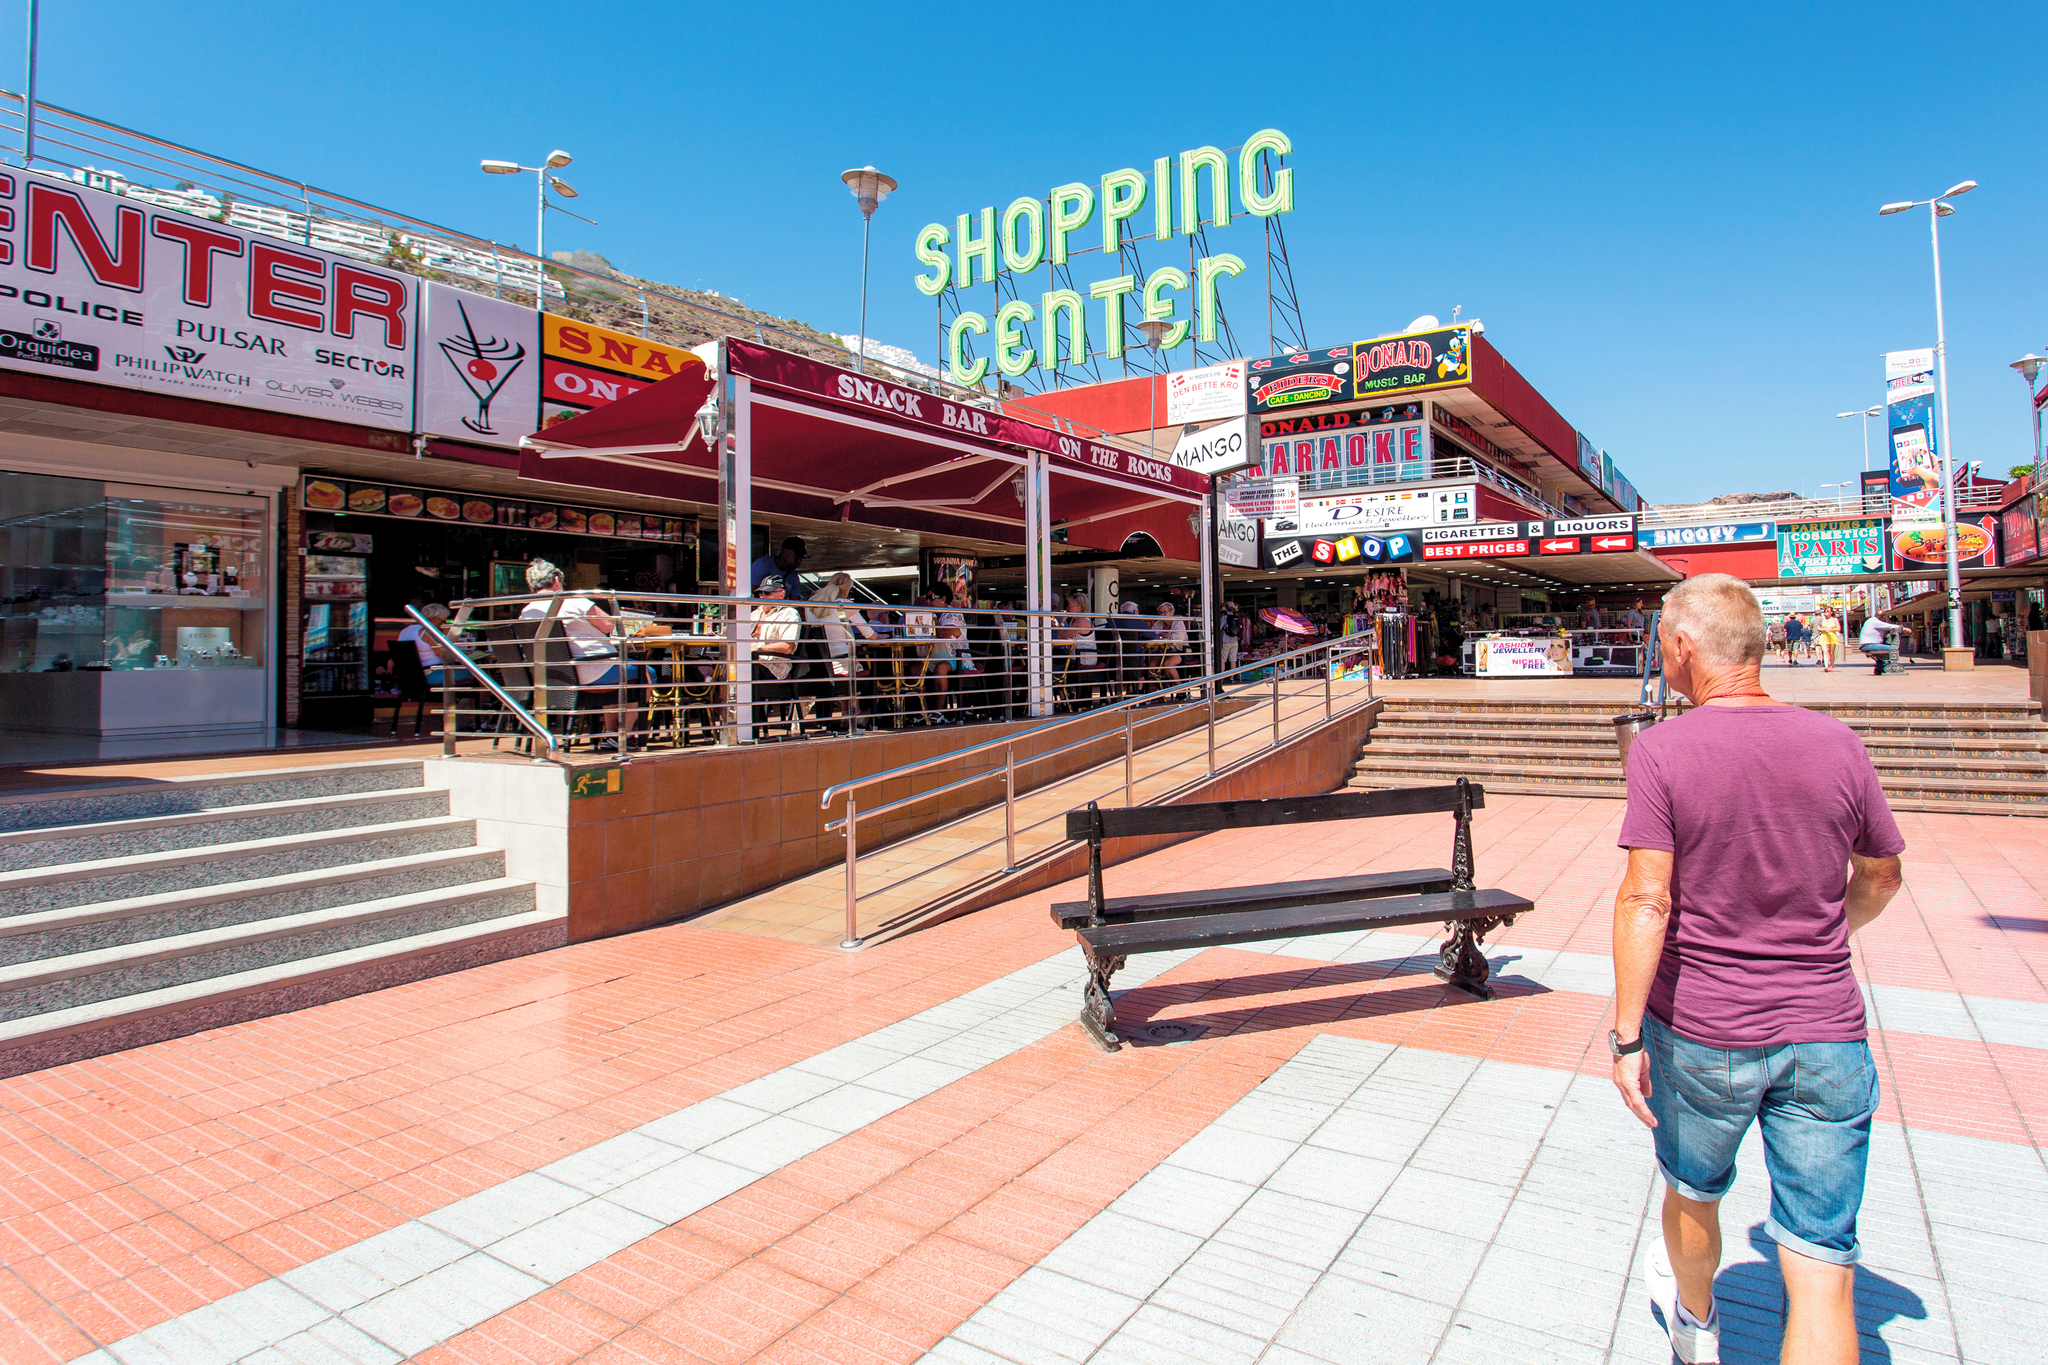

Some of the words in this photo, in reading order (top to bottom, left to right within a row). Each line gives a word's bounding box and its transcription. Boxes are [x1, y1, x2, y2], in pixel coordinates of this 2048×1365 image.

[915, 128, 1295, 297] SHOPPING
[949, 253, 1247, 386] CENTER
[176, 319, 288, 357] PULSAR
[16, 351, 43, 362] Perlas
[44, 356, 50, 364] y
[51, 357, 74, 367] joyas
[315, 349, 405, 379] SECTOR
[1356, 340, 1433, 383] DONALD
[123, 372, 153, 380] SWISS
[159, 377, 185, 385] MADE
[190, 382, 218, 391] SINCE
[554, 372, 621, 400] ON
[1173, 386, 1190, 398] DEN
[1192, 381, 1218, 391] BETTE
[1220, 381, 1239, 389] KRO
[1268, 376, 1329, 394] RIDER'S
[1365, 377, 1399, 390] MUSIC
[1403, 373, 1426, 384] BAR
[1890, 375, 1912, 390] FREE
[265, 379, 334, 399] OLIVER
[340, 392, 404, 412] WEBER
[1270, 396, 1289, 405] CAFE
[1294, 390, 1327, 401] DANCING
[304, 399, 370, 413] COLLECTION
[837, 373, 923, 418] SNACK
[942, 403, 988, 435] BAR
[1059, 436, 1082, 459] ON
[1090, 445, 1119, 470] THE
[1127, 456, 1172, 483] ROCKS
[1261, 411, 1351, 437] ONALD
[1176, 433, 1242, 468] MANGO
[1304, 518, 1363, 529] Electronics
[1374, 513, 1429, 525] Jewellery
[1328, 505, 1406, 520] DESIRE
[1218, 519, 1256, 543] ANGO
[1425, 526, 1515, 540] CIGARETTES
[1530, 524, 1541, 534] &
[1557, 520, 1629, 532] LIQUORS
[1791, 520, 1860, 532] PARFUMS
[1865, 519, 1875, 528] &
[1791, 528, 1878, 541] COSMETICS
[1654, 526, 1737, 546] SNOOPY
[1274, 544, 1298, 561] THE
[1315, 536, 1404, 560] SHOP
[1425, 546, 1463, 557] BEST
[1469, 543, 1526, 555] PRICES
[1793, 538, 1878, 558] PARIS
[933, 556, 960, 565] WANNA
[1798, 557, 1828, 567] FREE
[1829, 555, 1862, 565] ZONE
[1804, 565, 1853, 575] SERVICE
